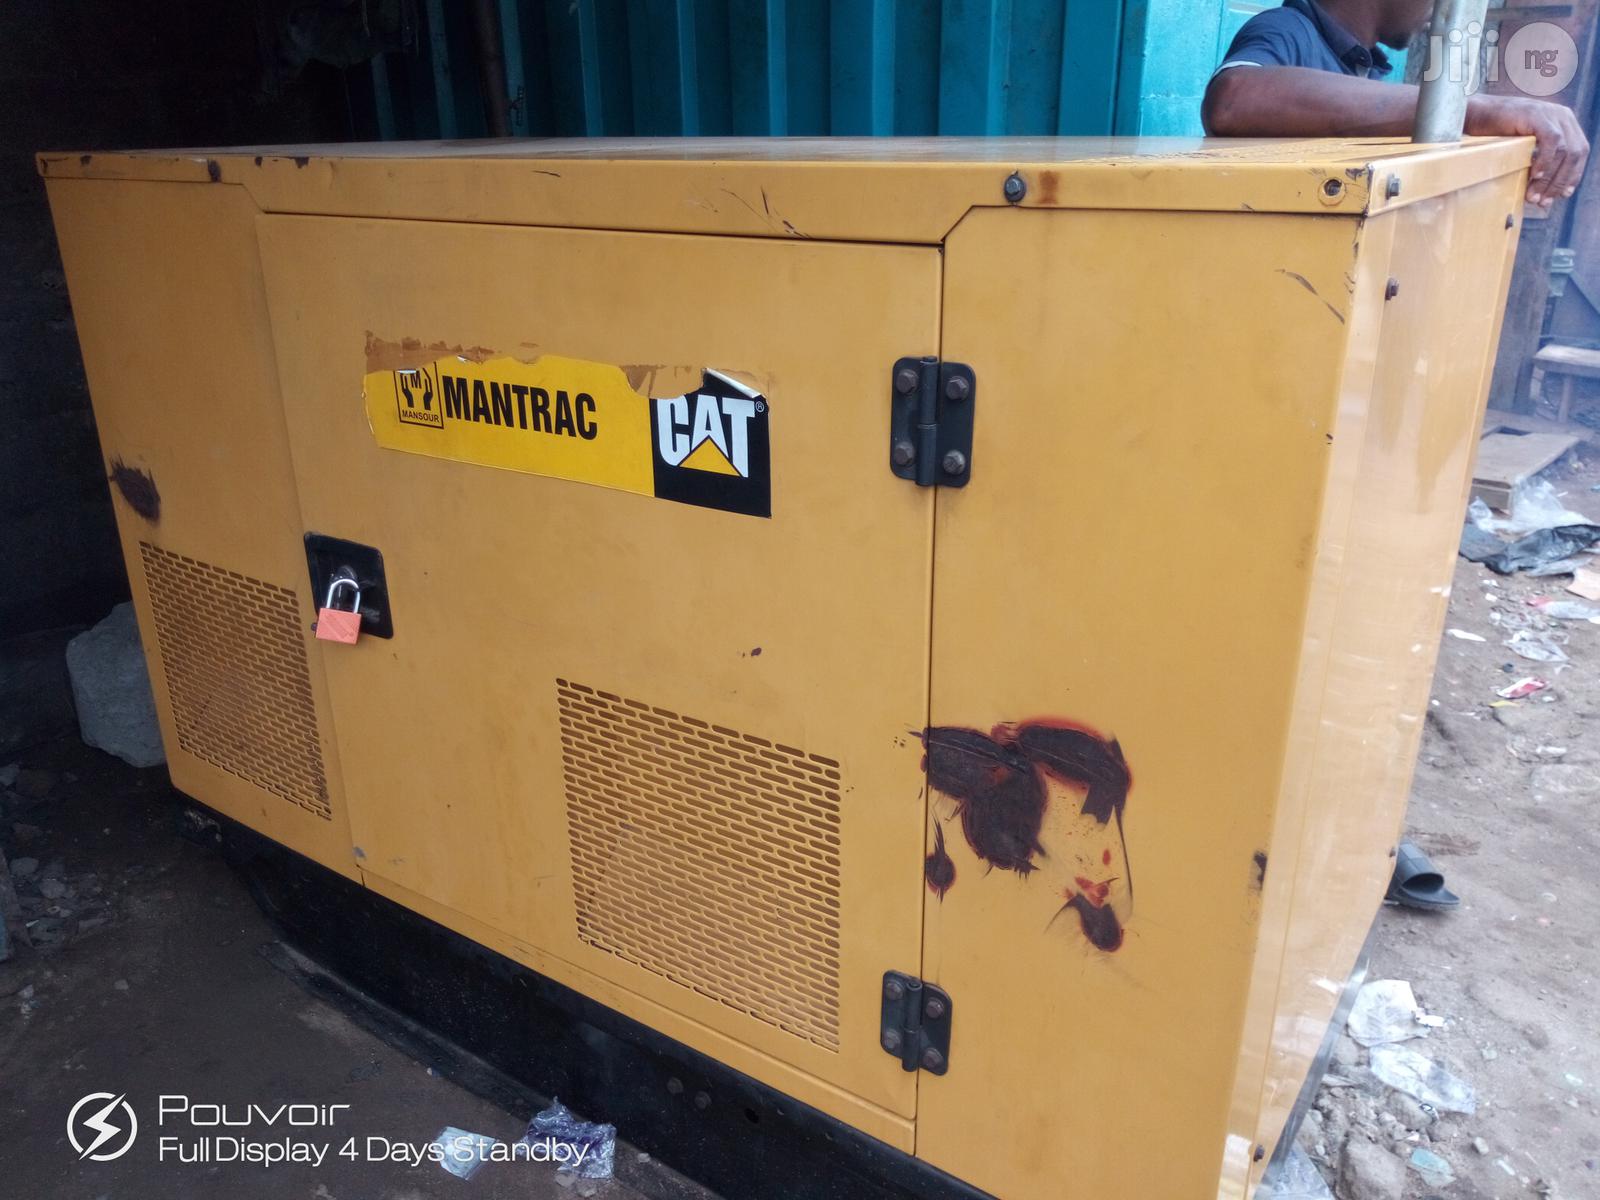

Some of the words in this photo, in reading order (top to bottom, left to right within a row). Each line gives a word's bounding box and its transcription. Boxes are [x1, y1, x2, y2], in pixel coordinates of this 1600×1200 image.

[401, 409, 440, 423] MANSOUR
[442, 375, 598, 440] MANTRAC
[656, 394, 756, 478] CAT
